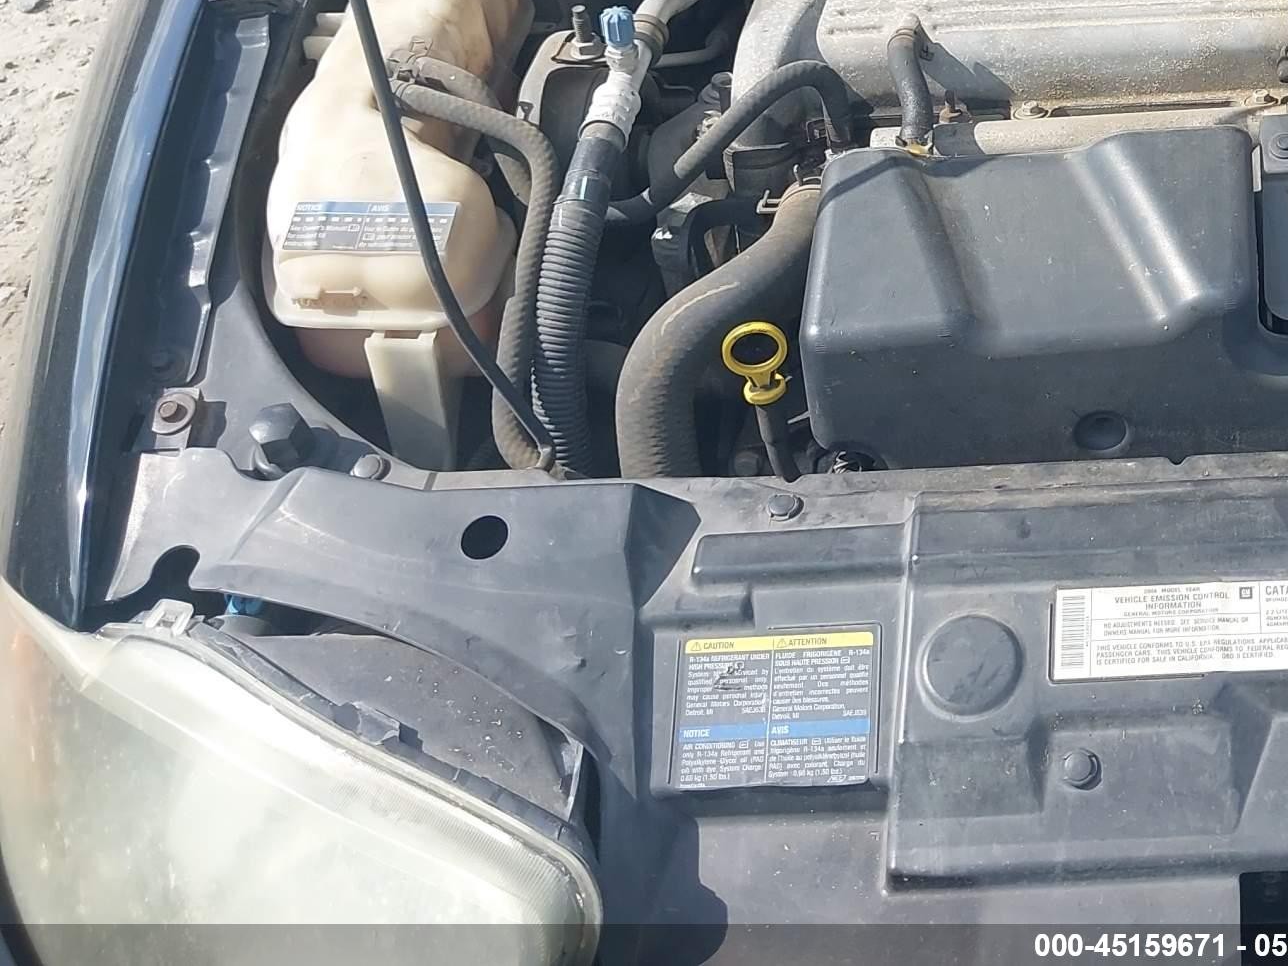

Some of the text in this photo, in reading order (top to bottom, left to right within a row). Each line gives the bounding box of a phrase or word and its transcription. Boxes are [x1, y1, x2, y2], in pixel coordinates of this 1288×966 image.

[1114, 591, 1229, 604] VEHICLE EMISSION CONTROL
[1145, 601, 1202, 610] INFORMATION
[788, 638, 827, 646] ATTENTION
[1112, 643, 1137, 651] VEHICLE
[1104, 657, 1136, 665] CERTIFIED
[683, 729, 711, 738] NOTICE
[771, 726, 789, 734] AVIS
